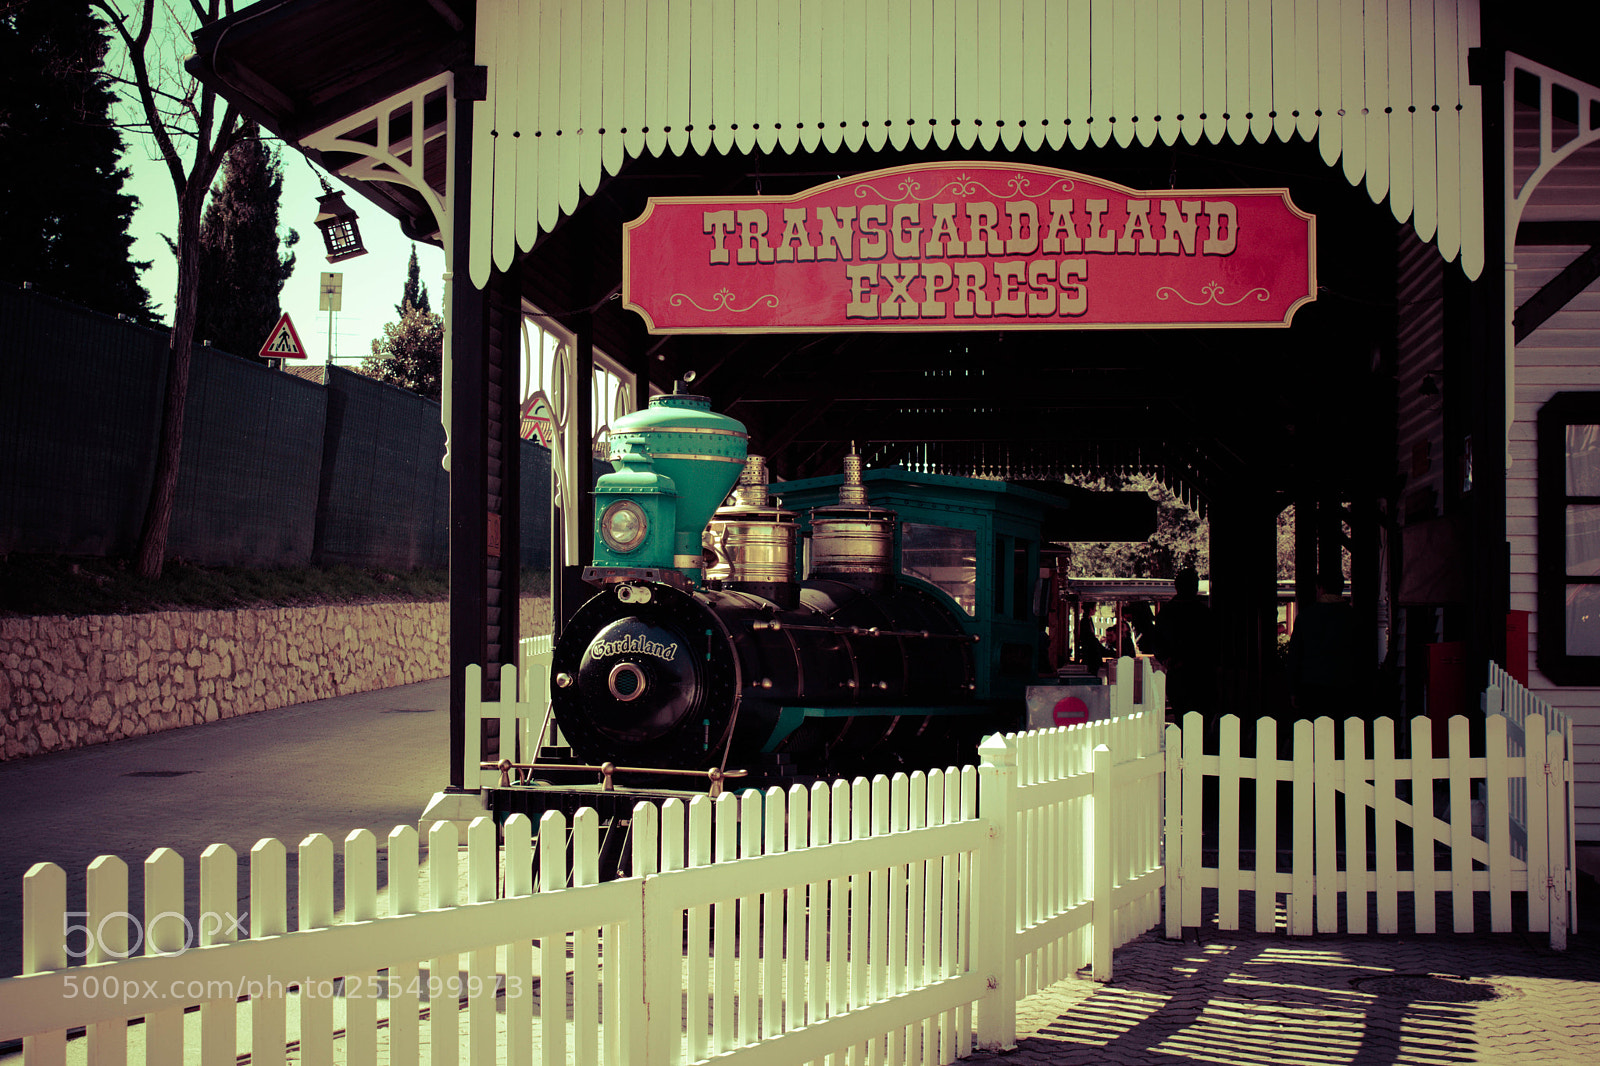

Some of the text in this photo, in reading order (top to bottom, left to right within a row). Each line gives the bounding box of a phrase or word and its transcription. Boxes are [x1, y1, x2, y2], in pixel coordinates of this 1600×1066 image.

[703, 199, 1238, 265] TRANSGARDALAND
[846, 259, 1089, 319] EXPRESS
[591, 634, 678, 661] Gardaland
